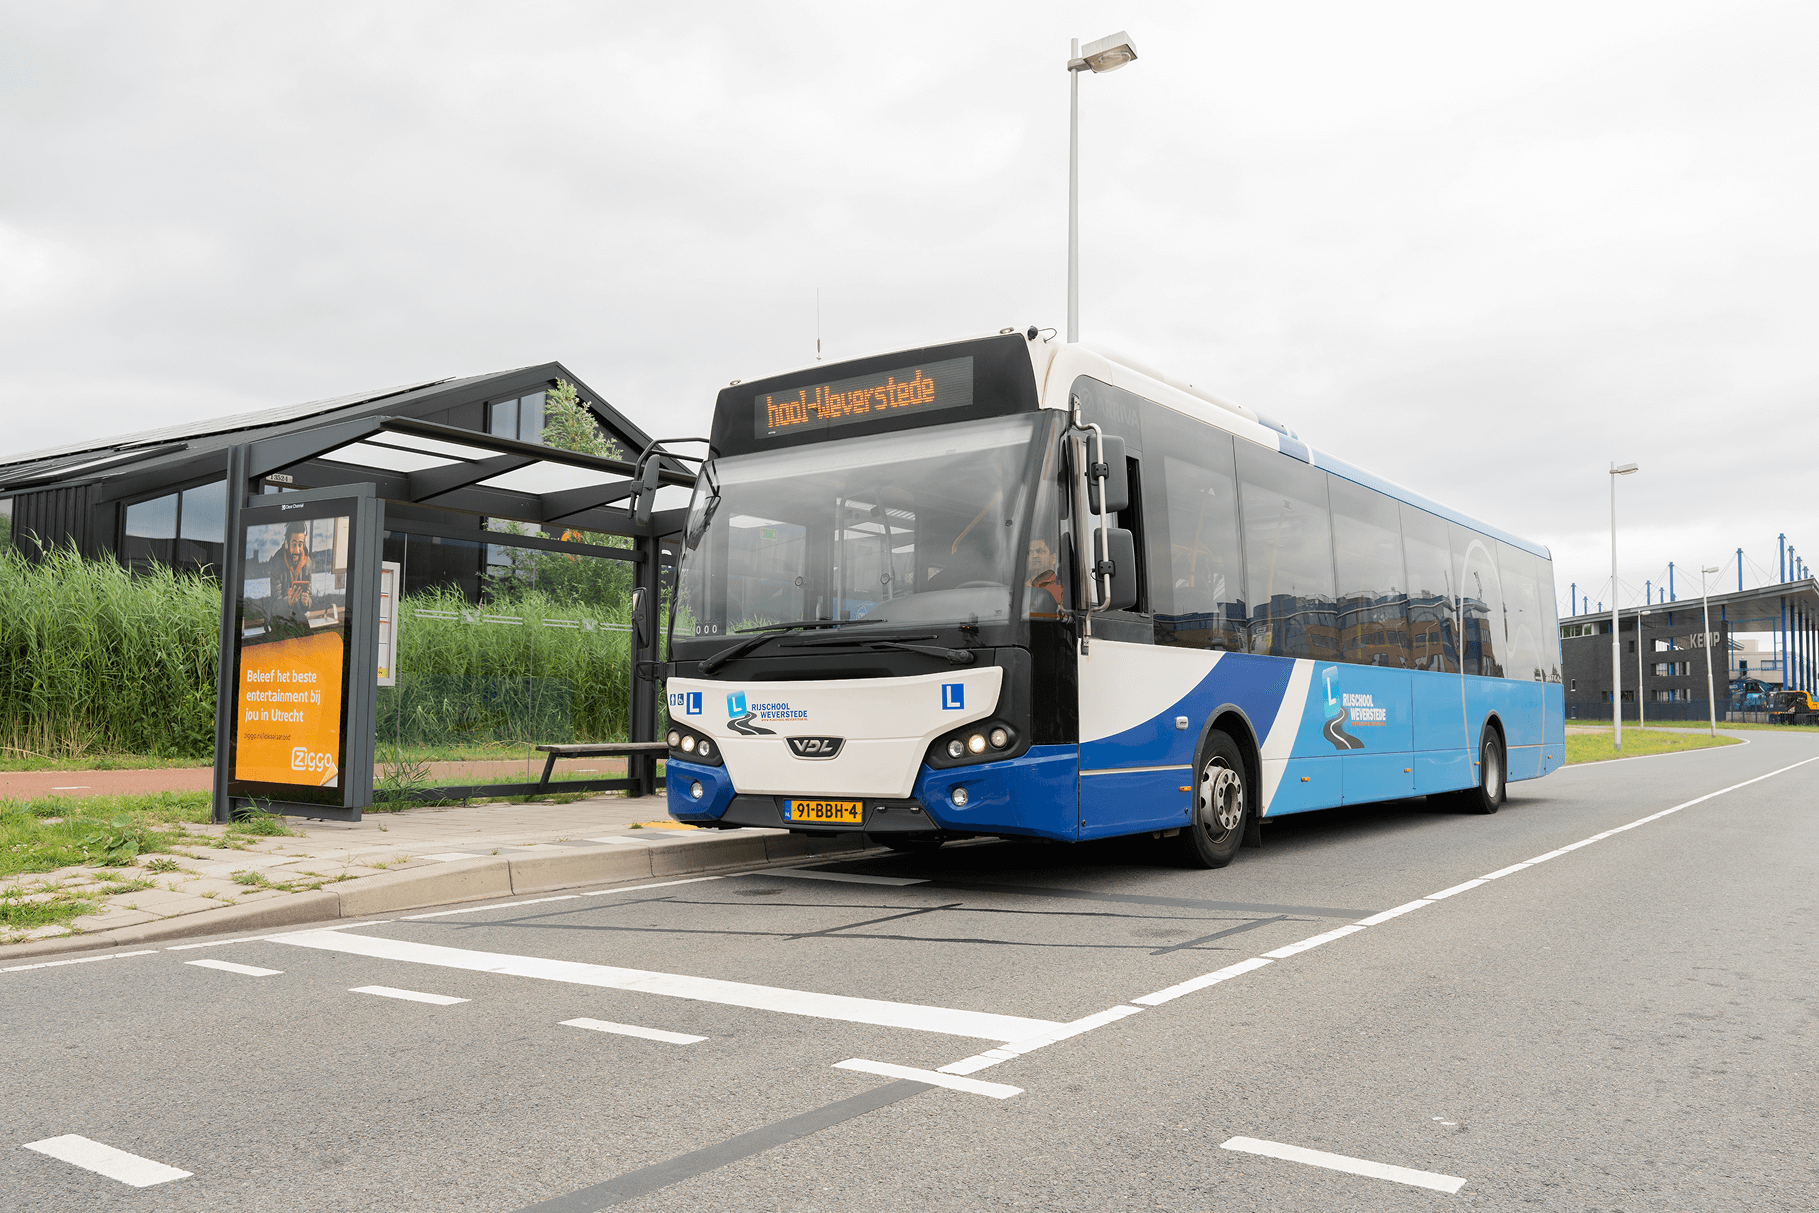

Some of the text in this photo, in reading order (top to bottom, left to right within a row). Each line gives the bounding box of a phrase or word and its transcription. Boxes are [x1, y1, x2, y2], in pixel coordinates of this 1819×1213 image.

[246, 669, 317, 683] Beleef het beste
[246, 689, 321, 705] entertainment bij
[946, 685, 961, 708] L
[1327, 677, 1337, 706] L
[690, 693, 699, 713] L
[752, 703, 790, 711] RIJSCHOOL
[1343, 693, 1373, 707] RIJSCHOOL
[245, 708, 304, 722] jou in Utrecht
[760, 710, 808, 718] WEVERSTEDE
[1350, 708, 1386, 720] WEVERSTEDE
[794, 740, 833, 752] VDL
[796, 803, 858, 819] 91-BBH-4
